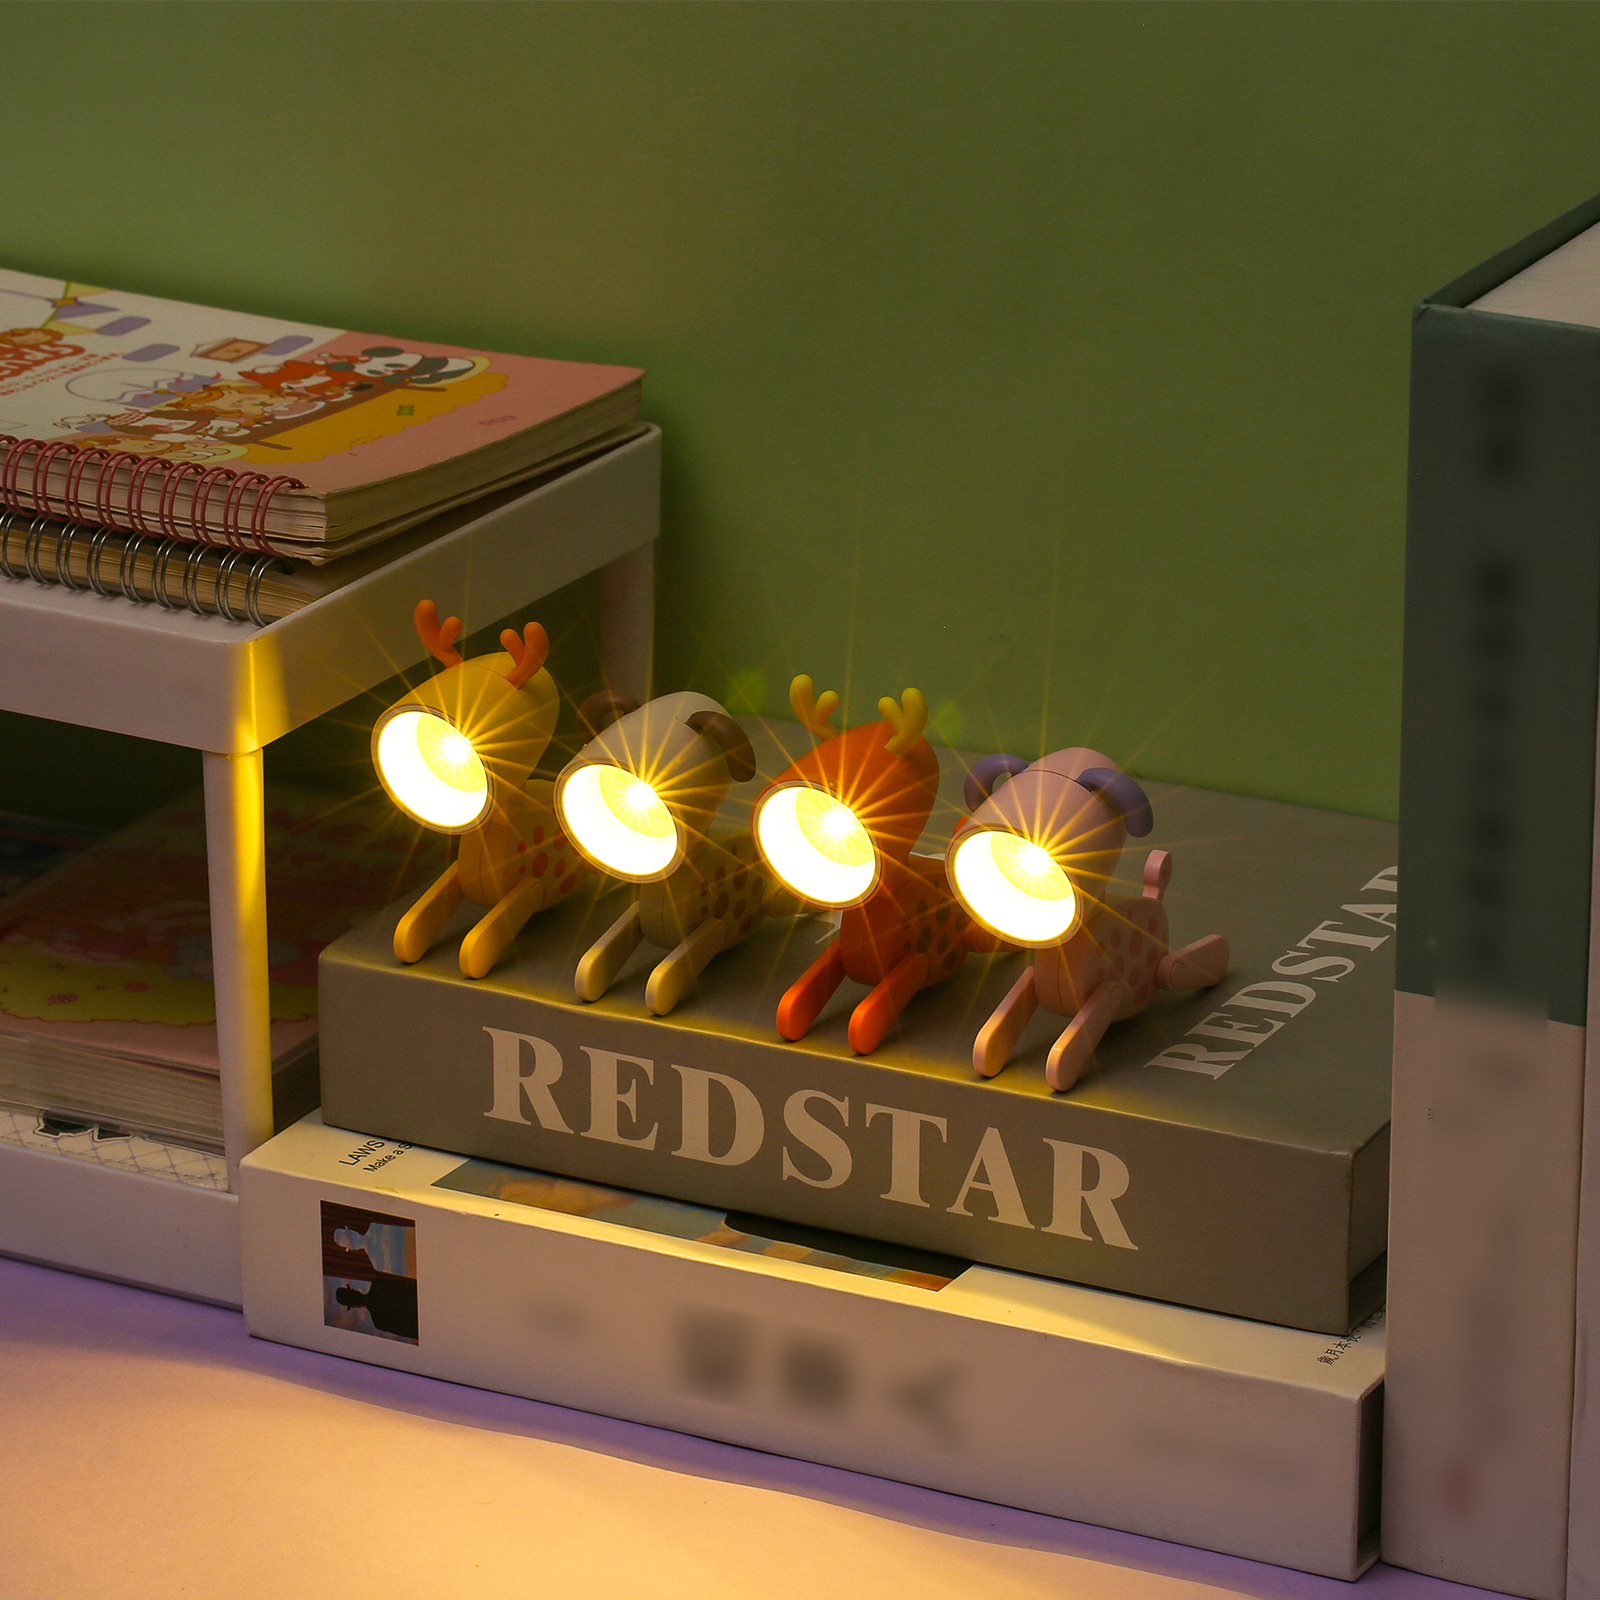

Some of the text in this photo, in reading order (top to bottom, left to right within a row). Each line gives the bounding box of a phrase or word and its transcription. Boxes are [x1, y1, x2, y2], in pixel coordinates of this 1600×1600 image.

[482, 1026, 1139, 1250] REDSTAR
[338, 1140, 385, 1166] LAWS
[363, 1154, 396, 1172] Make
